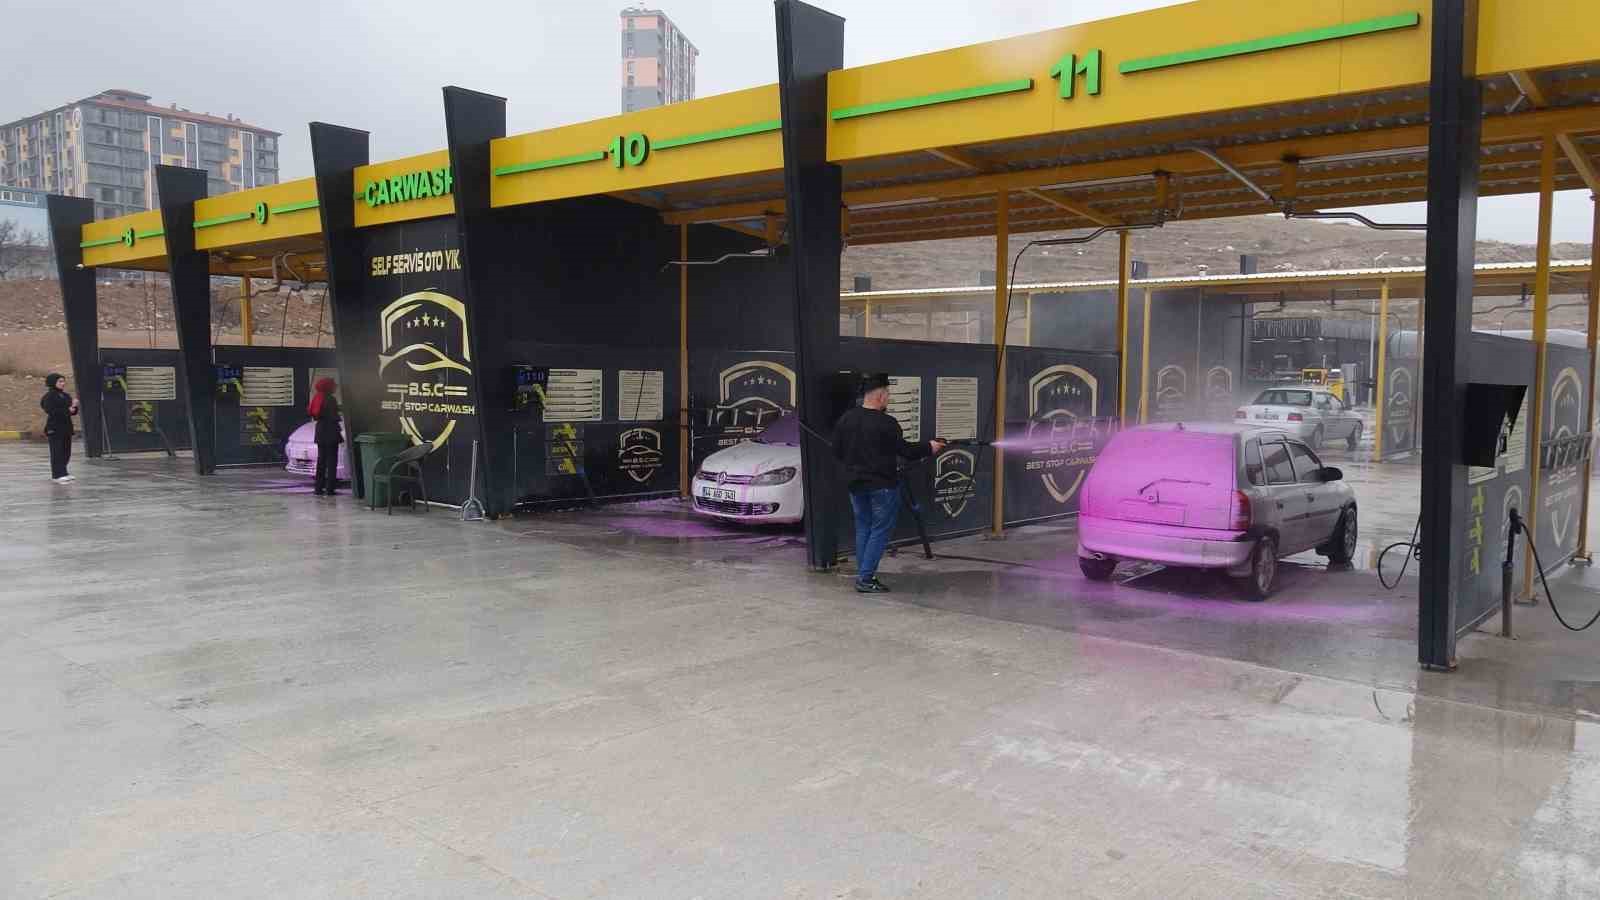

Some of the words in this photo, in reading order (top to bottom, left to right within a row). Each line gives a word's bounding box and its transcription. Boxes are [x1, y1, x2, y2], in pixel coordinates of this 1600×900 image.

[1049, 49, 1102, 98] 11
[608, 133, 649, 168] 10
[255, 202, 268, 224] 9
[124, 228, 134, 247] 8
[372, 256, 391, 276] SELF
[393, 248, 424, 274] SERVİS
[424, 250, 443, 272] OTO
[445, 249, 461, 270] YIK
[408, 383, 443, 397] B.S.C
[382, 401, 401, 409] BEST
[404, 402, 427, 411] STOP
[428, 404, 475, 415] CARWASH
